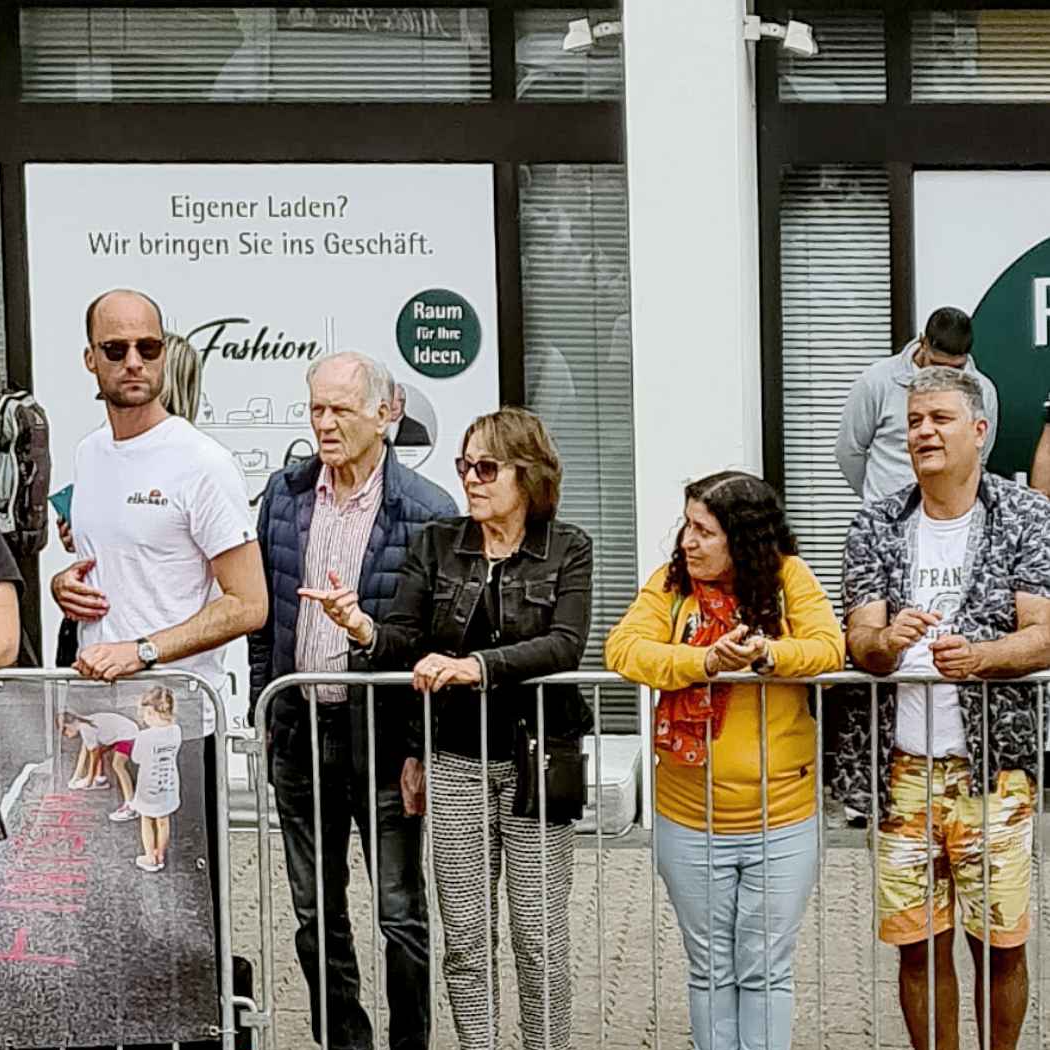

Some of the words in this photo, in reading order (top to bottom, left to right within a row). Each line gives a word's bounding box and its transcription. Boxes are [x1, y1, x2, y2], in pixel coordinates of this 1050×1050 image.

[170, 195, 259, 224] Eigener
[267, 194, 349, 218] Laden?
[88, 232, 131, 255] Wir
[139, 232, 229, 262] bringen
[238, 232, 273, 255] Sie
[282, 232, 315, 255] ins
[324, 232, 435, 255] Geschäft.
[412, 301, 463, 320] Raum
[186, 317, 322, 362] Fashion
[416, 327, 435, 340] für
[437, 327, 462, 340] Ihre
[412, 345, 466, 365] Ideen.
